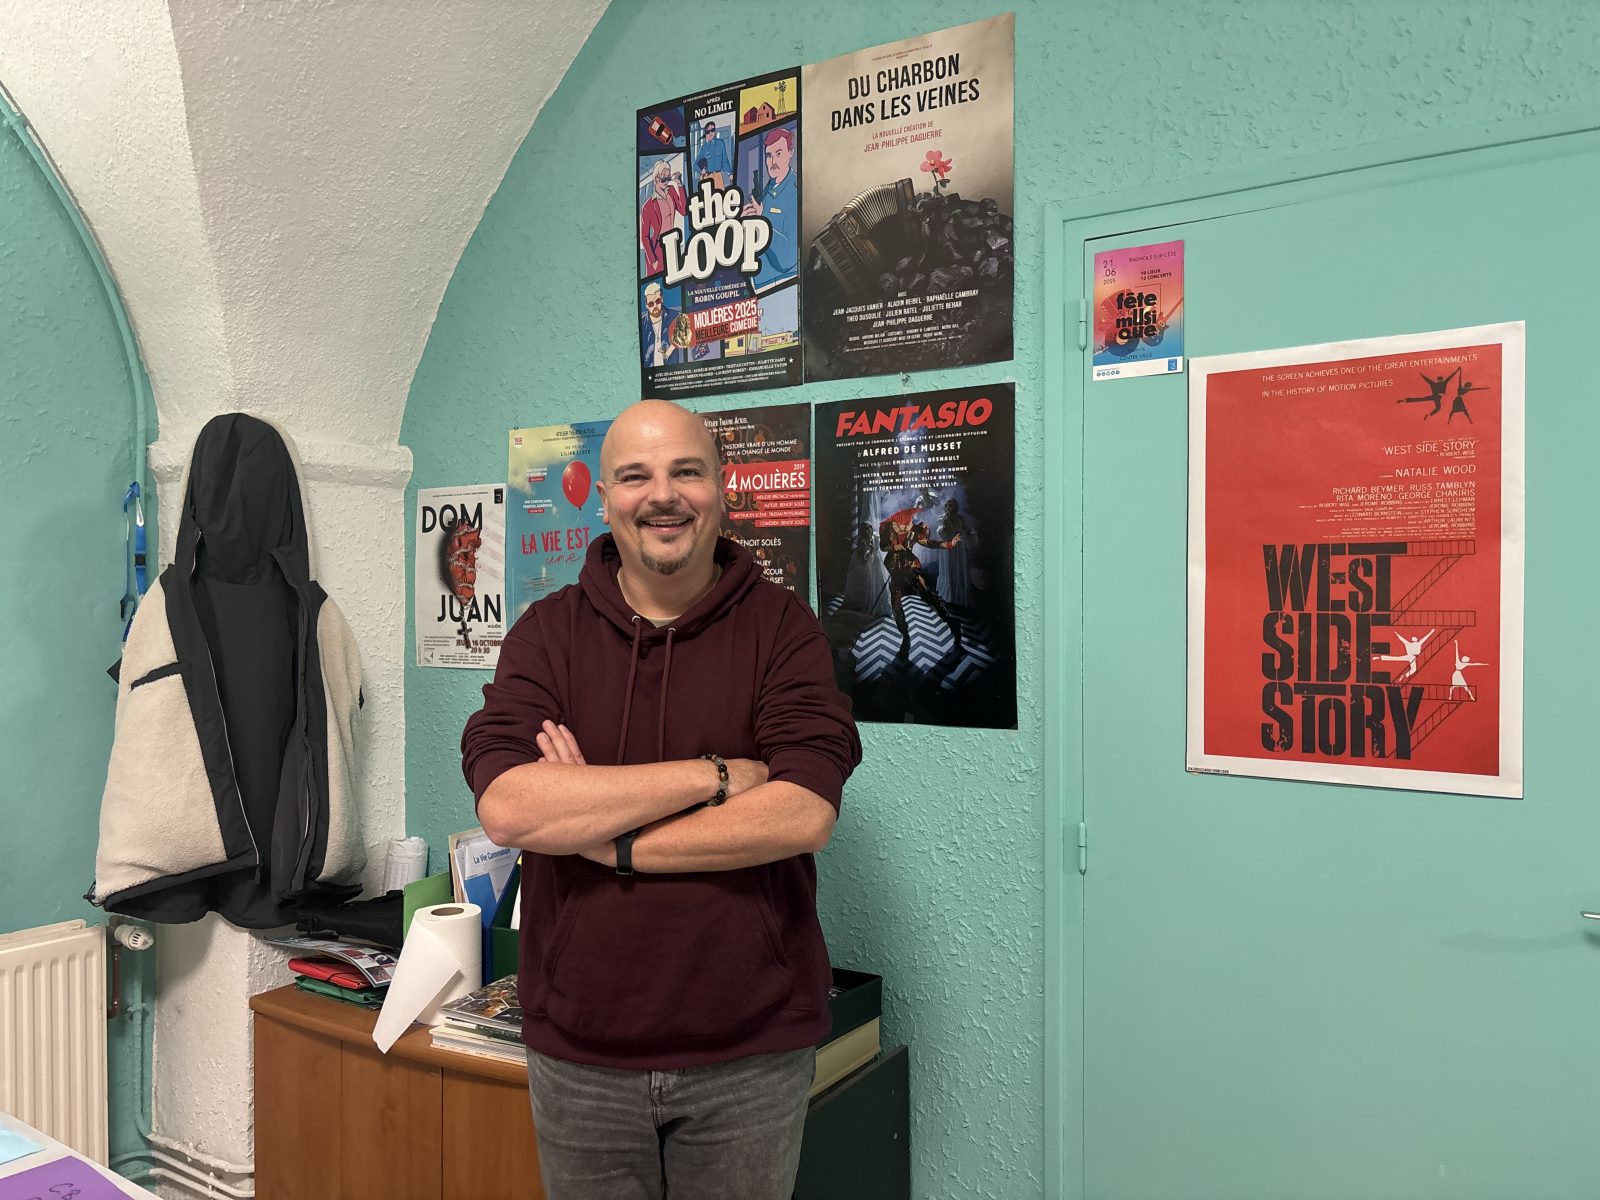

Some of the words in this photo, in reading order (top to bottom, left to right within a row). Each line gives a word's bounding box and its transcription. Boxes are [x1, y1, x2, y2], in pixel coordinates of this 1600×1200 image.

[848, 75, 870, 100] DU
[877, 53, 960, 93] CHARBON
[694, 107, 706, 119] NO
[708, 100, 734, 115] LIMIT
[831, 103, 875, 132] DANS
[881, 94, 911, 121] LES
[917, 78, 980, 112] VEINES
[864, 135, 909, 152] JEAN-PHILIPPE
[910, 129, 943, 143] DAGUERRE
[872, 131, 879, 140] LA
[879, 127, 903, 138] NOUVELLE
[903, 122, 927, 133] CRÉATION
[689, 181, 740, 230] the
[663, 218, 770, 285] LOOP
[694, 294, 715, 303] ROBIN
[715, 290, 740, 300] GOUPIL
[955, 288, 979, 299] CAMBRAY
[1116, 291, 1157, 310] fête
[693, 305, 734, 329] MOLIÈRES
[734, 299, 757, 320] 2025
[885, 309, 903, 318] JULIEN
[922, 302, 945, 313] JULIETTE
[908, 313, 933, 323] DAGUERRE
[1116, 307, 1157, 328] musi
[695, 323, 729, 340] MEILLEURE
[729, 316, 758, 333] COMÉDIE
[1118, 324, 1157, 340] que
[1276, 372, 1303, 381] SCREEN
[1305, 368, 1339, 379] ACHIEVES
[1340, 366, 1356, 375] ONE
[1357, 365, 1367, 373] OF
[1367, 363, 1382, 373] THE
[1384, 360, 1408, 370] GREAT
[1409, 353, 1478, 368] ENTERTAINMENTS
[1261, 390, 1269, 398] IN
[1270, 389, 1284, 397] THE
[1286, 386, 1316, 396] HISTORY
[1317, 385, 1327, 393] OF
[1328, 382, 1357, 392] MOTION
[1358, 379, 1393, 390] PICTURES
[835, 398, 993, 438] FANTASIO
[776, 438, 798, 446] HOMME
[903, 444, 916, 454] DE
[920, 441, 962, 452] MUSSET
[1416, 442, 1438, 454] SIDE
[793, 463, 805, 471] 2019
[892, 457, 926, 466] EMMANUEL
[1395, 466, 1438, 478] NATALIE
[1443, 464, 1476, 475] WOOD
[726, 470, 738, 491] 4
[740, 468, 806, 491] MOLIÈRES
[1332, 486, 1367, 495] RICHARD
[1370, 484, 1404, 493] BEYMER
[1409, 483, 1433, 491] RUSS
[1435, 481, 1476, 489] TAMBLYN
[1357, 493, 1392, 501] MORENO
[1398, 491, 1431, 500] GEORGE
[1435, 489, 1476, 498] CHAKIRIS
[422, 502, 483, 533] DOM
[521, 533, 538, 555] LA
[566, 527, 590, 550] EST
[761, 536, 782, 547] SOLÈS
[1263, 541, 1408, 613] WEST
[437, 594, 502, 622] JUAN
[472, 639, 479, 647] 16
[1261, 611, 1392, 684] SIDE
[1261, 682, 1425, 760] STORY
[473, 856, 480, 864] La
[480, 853, 488, 862] Vie
